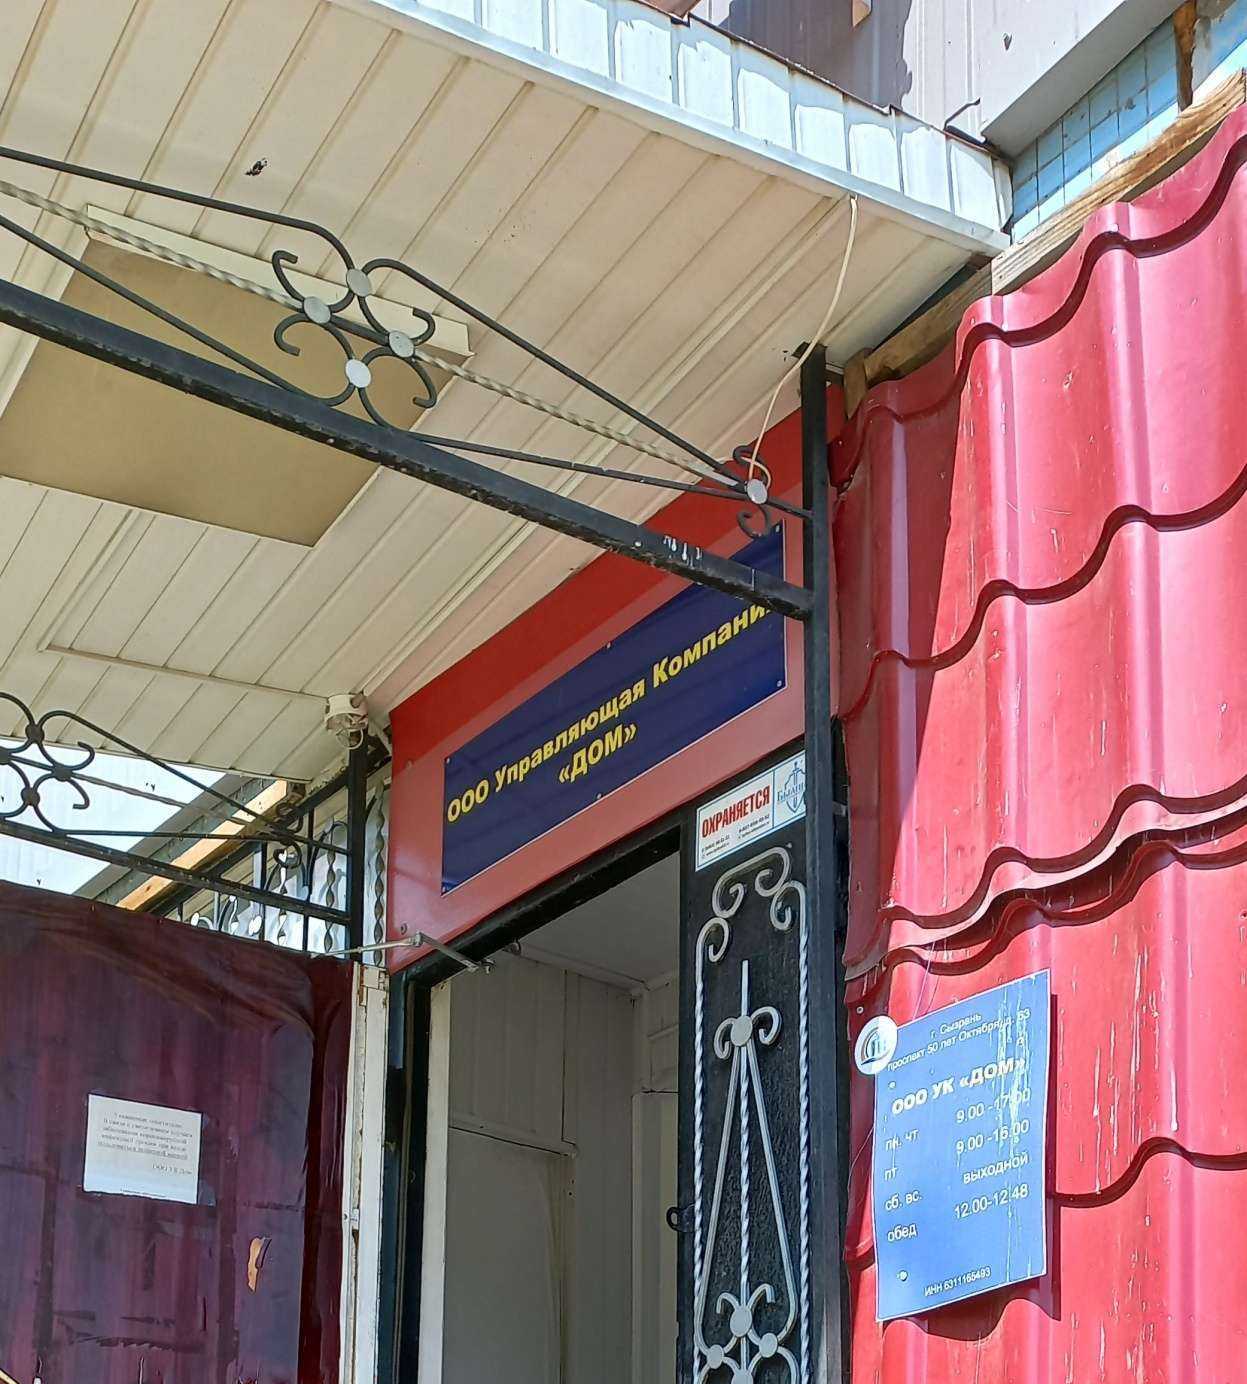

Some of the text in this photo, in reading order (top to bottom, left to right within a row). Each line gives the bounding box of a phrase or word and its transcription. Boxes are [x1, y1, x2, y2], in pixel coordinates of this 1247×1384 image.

[447, 603, 772, 822] ООО Управляющая Компани
[558, 723, 637, 783] «ДОМ»
[702, 785, 770, 838] ОХРАНЯЕТСЯ
[939, 1013, 982, 1035] Сызрань
[887, 1050, 927, 1071] проспект
[927, 1042, 939, 1055] 50
[940, 1037, 957, 1049] лет
[892, 1057, 1026, 1115] ООО УК «ДОМ»
[905, 1129, 919, 1142] чт
[884, 1167, 897, 1181] пт
[962, 1152, 1029, 1184] выходной
[887, 1224, 917, 1242] обед
[924, 1281, 943, 1297] ИНН
